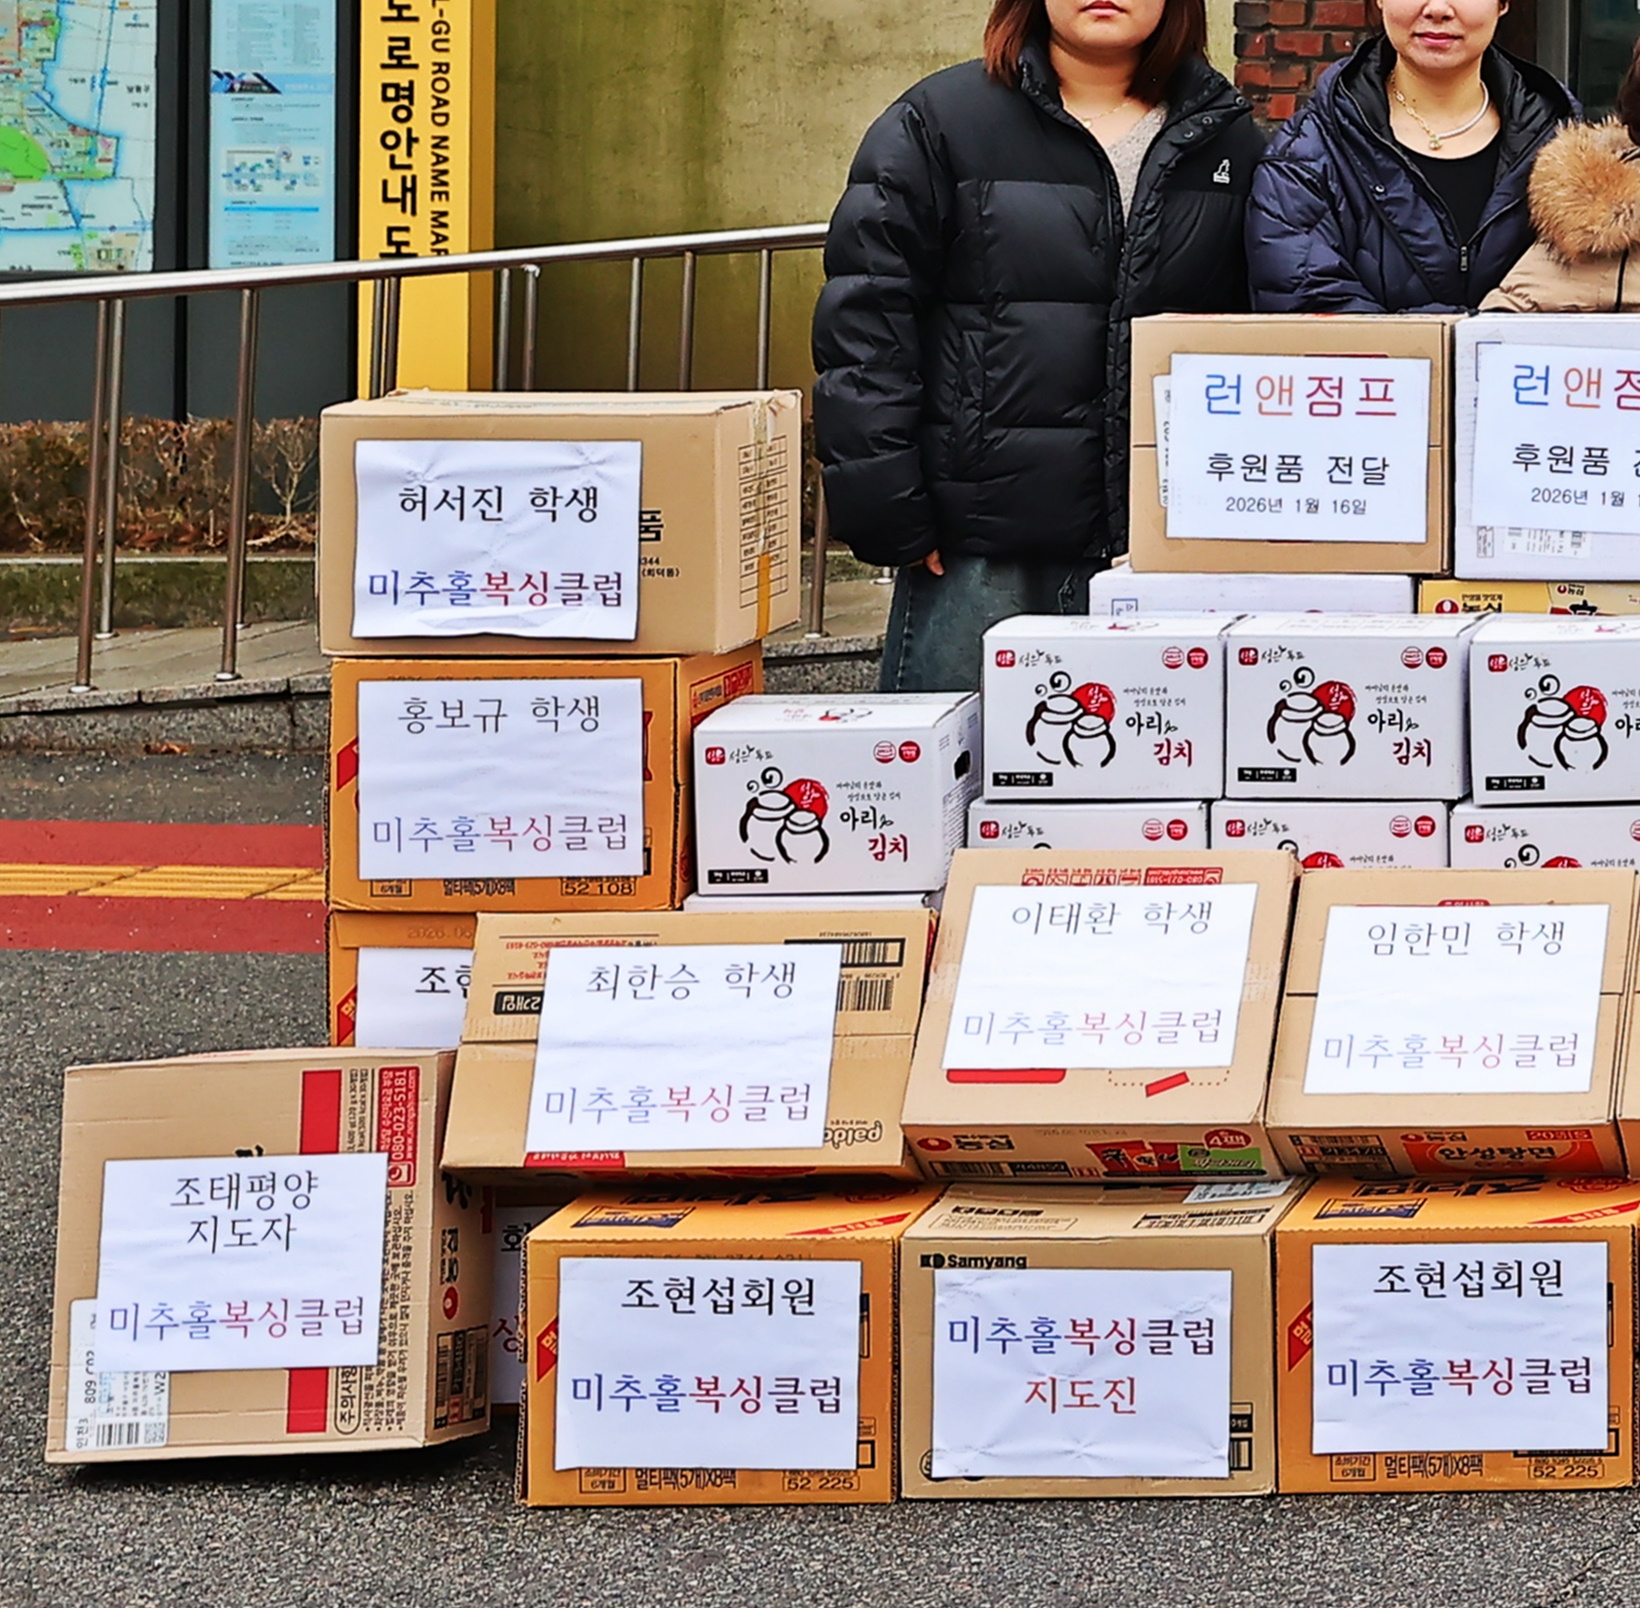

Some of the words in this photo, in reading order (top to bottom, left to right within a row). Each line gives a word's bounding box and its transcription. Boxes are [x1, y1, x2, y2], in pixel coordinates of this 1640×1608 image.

[431, 61, 450, 128] ROAD
[431, 135, 449, 203] NAME
[1205, 374, 1397, 417] 런앤점프
[1207, 453, 1303, 483] 후원품
[1327, 456, 1389, 485] 전달
[399, 485, 503, 521] 허서진
[529, 486, 597, 523] 학생
[370, 570, 621, 607] 미추홀복싱클럽
[398, 697, 507, 734] 홍보규
[531, 696, 599, 732] 학생
[1154, 737, 1194, 768] 김치
[374, 814, 626, 853] 미추홀복싱클럽
[868, 833, 909, 863] 김치
[1012, 902, 1115, 934] 이태환
[1145, 901, 1212, 934] 학생
[1368, 922, 1470, 955] 임한민
[1498, 921, 1564, 955] 학생
[587, 964, 699, 1000] 최한승
[726, 962, 795, 998] 학생
[964, 1009, 1227, 1052] 미추홀복싱클럽
[1324, 1033, 1582, 1073] 미추홀복싱클럽
[546, 1083, 817, 1131] 미추홀복싱클럽
[171, 1170, 318, 1211] 조태평양
[188, 1213, 296, 1254] 지도자
[947, 1254, 1027, 1270] Samyang
[1374, 1260, 1563, 1298] 조현섭회원
[622, 1276, 814, 1316] 조현섭회원
[110, 1296, 363, 1341] 미추홀복싱클럽
[949, 1316, 1213, 1355] 미추홀복싱클럽
[572, 1373, 840, 1414] 미추홀복싱클럽
[1025, 1377, 1136, 1414] 지도진
[1328, 1357, 1590, 1397] 미추홀복싱클럽
